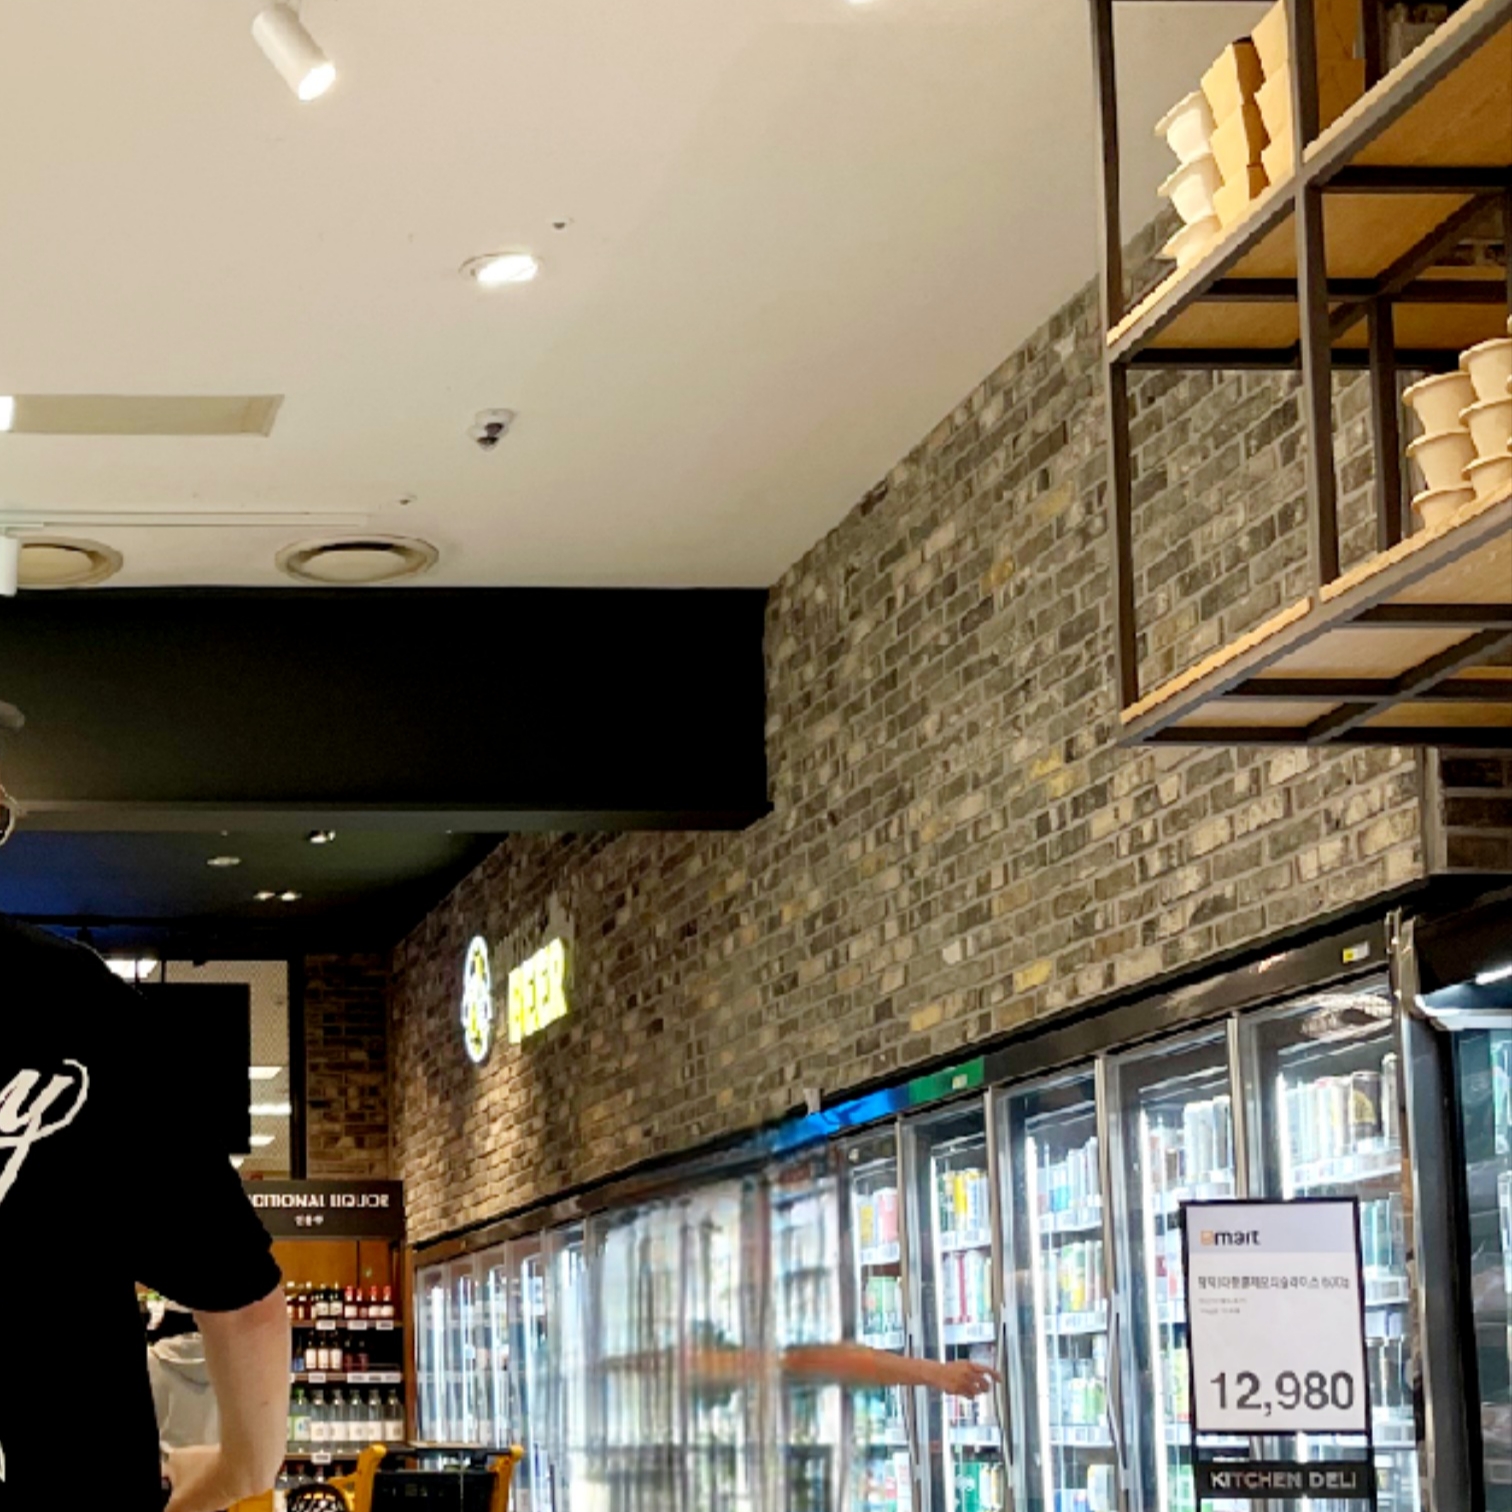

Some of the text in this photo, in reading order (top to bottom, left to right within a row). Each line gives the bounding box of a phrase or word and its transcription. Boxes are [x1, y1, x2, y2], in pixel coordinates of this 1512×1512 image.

[508, 937, 567, 1044] BEER
[248, 1193, 390, 1208] DITIONAL LIQUOR
[1210, 1370, 1354, 1416] 12,980
[1210, 1471, 1357, 1489] KITCHEN DELI
